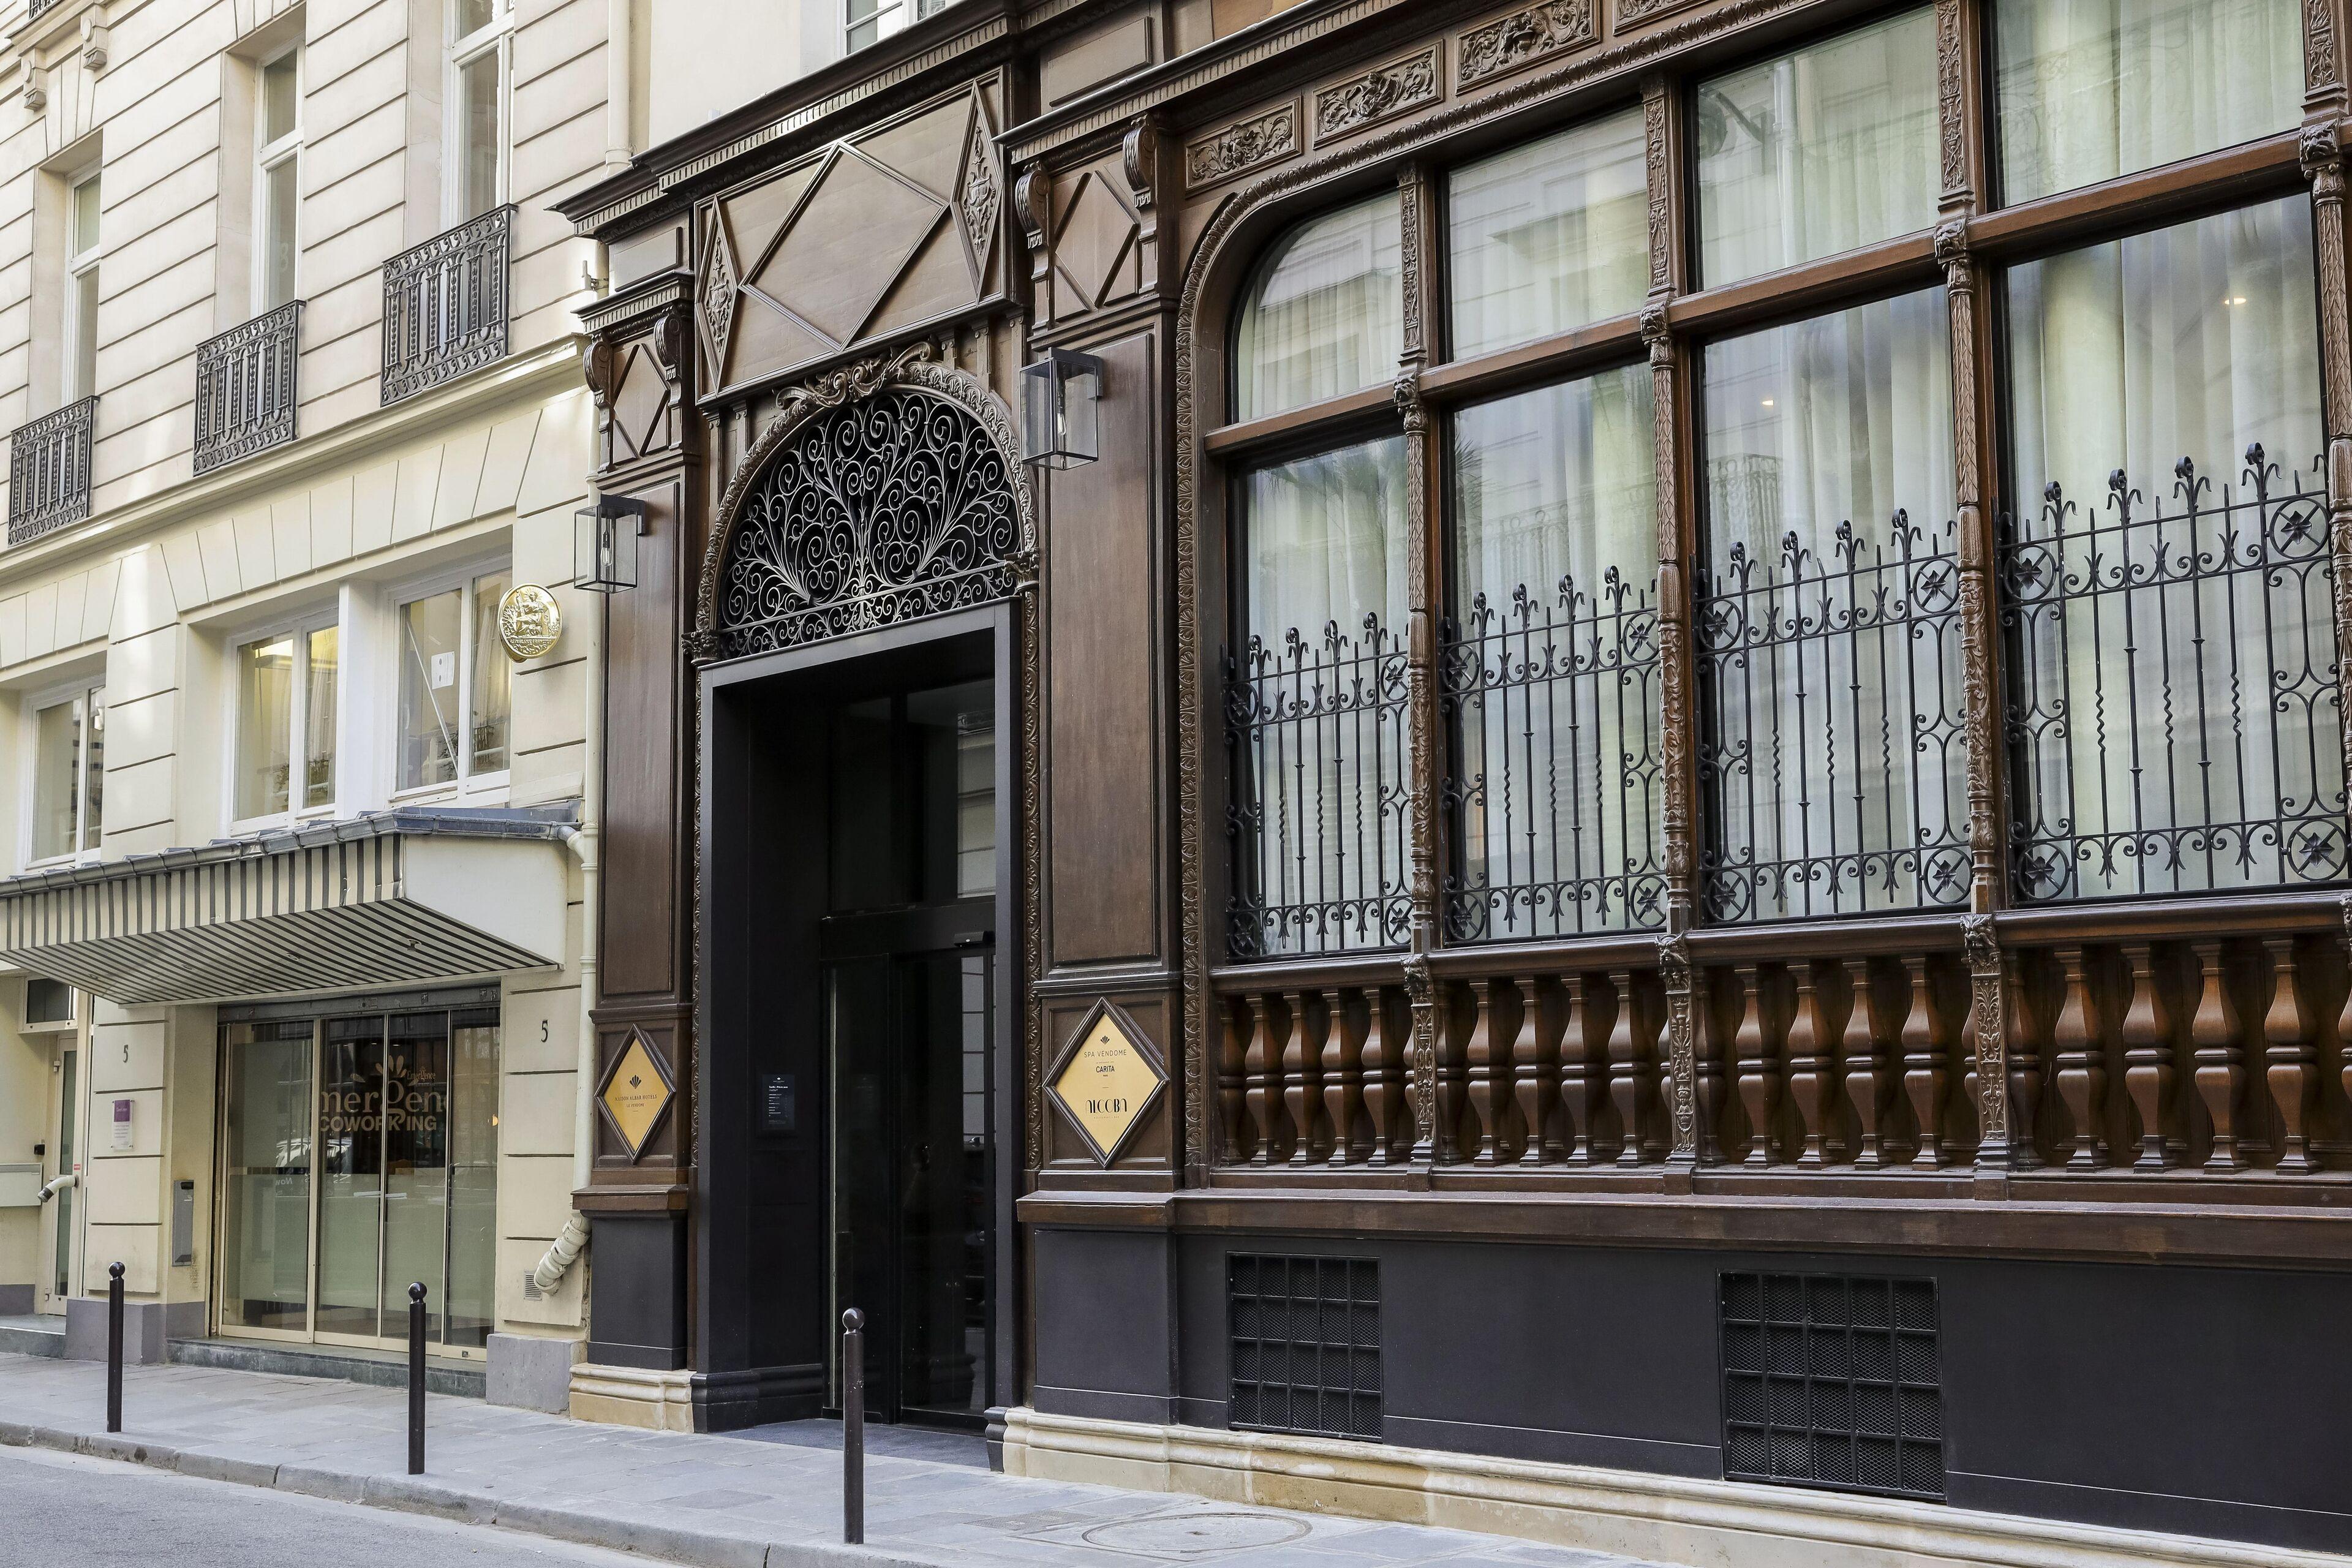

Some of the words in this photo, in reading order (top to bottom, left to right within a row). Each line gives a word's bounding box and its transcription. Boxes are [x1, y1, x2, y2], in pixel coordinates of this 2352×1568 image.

[541, 1018, 548, 1042] 5
[123, 1044, 128, 1063] 5
[1097, 1049, 1127, 1057] VENDOME
